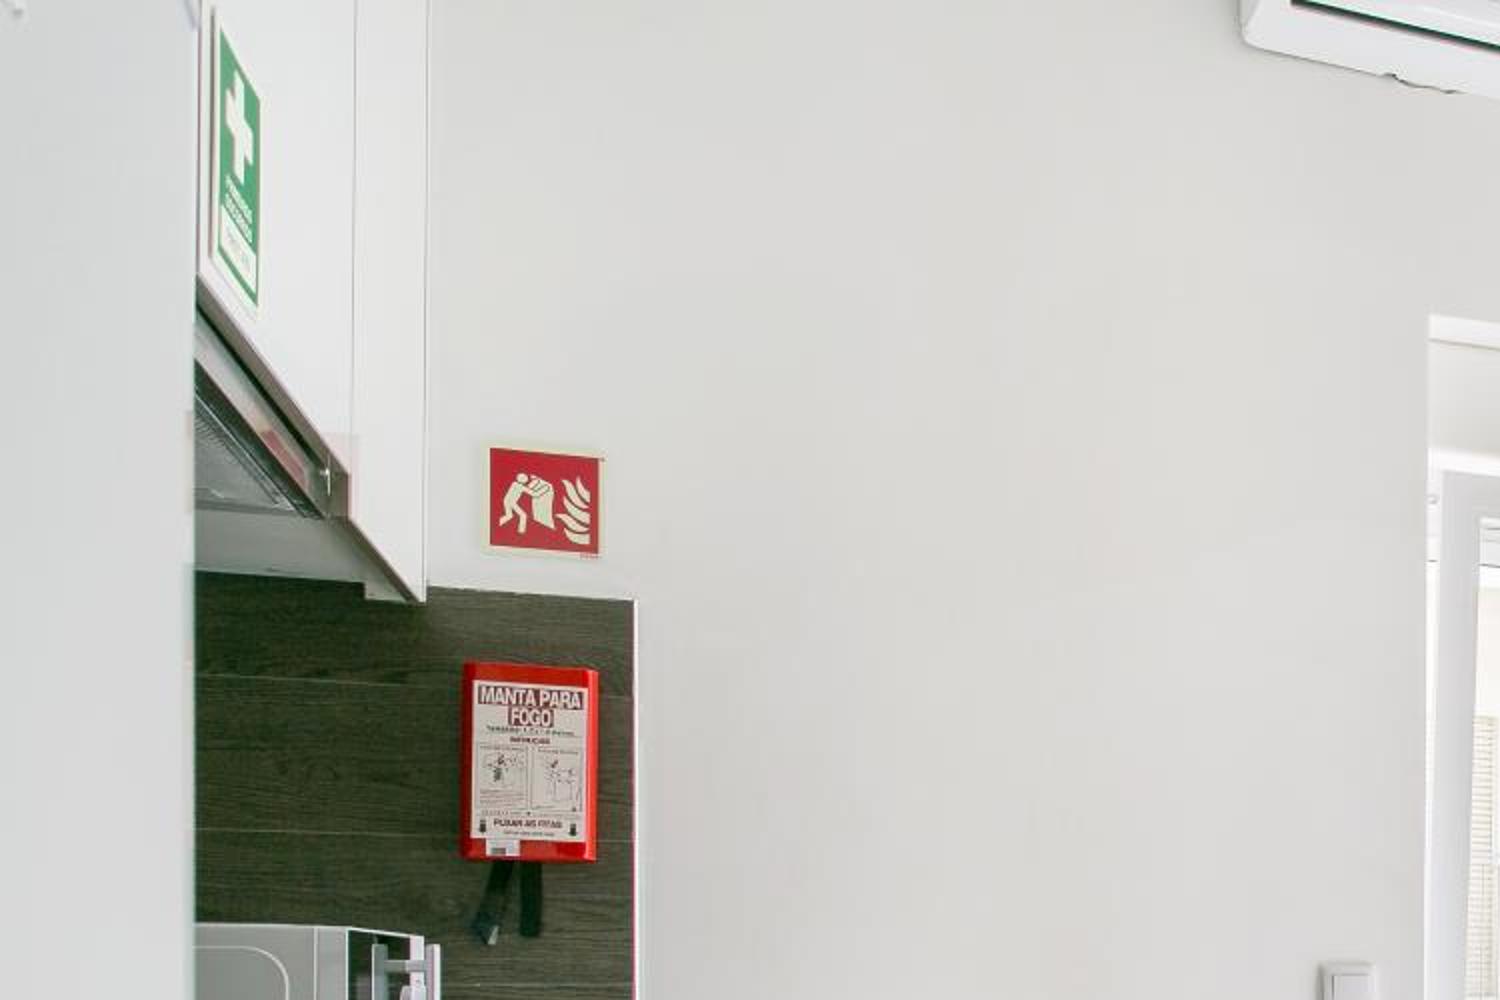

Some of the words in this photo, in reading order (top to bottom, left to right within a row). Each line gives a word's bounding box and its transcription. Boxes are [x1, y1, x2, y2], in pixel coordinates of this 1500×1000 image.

[480, 685, 537, 708] MANTA
[539, 690, 582, 710] PARA
[510, 706, 552, 728] FOGO
